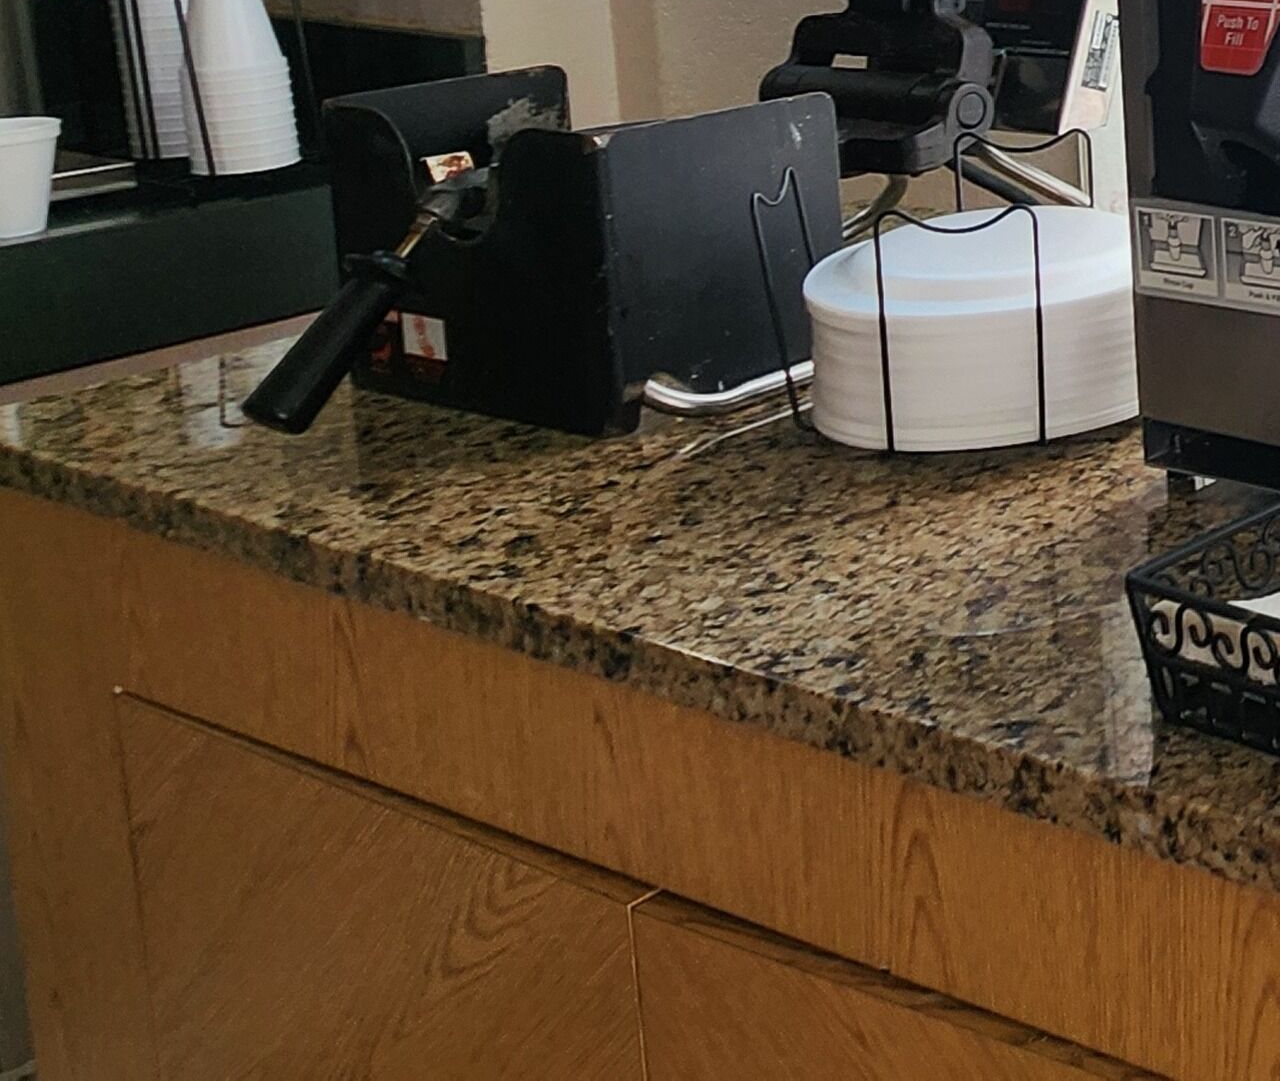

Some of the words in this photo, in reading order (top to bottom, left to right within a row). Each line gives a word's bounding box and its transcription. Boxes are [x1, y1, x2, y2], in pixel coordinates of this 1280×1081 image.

[1216, 14, 1244, 29] Push
[1246, 16, 1260, 31] To
[1224, 31, 1244, 46] Fill
[1228, 224, 1239, 238] 2
